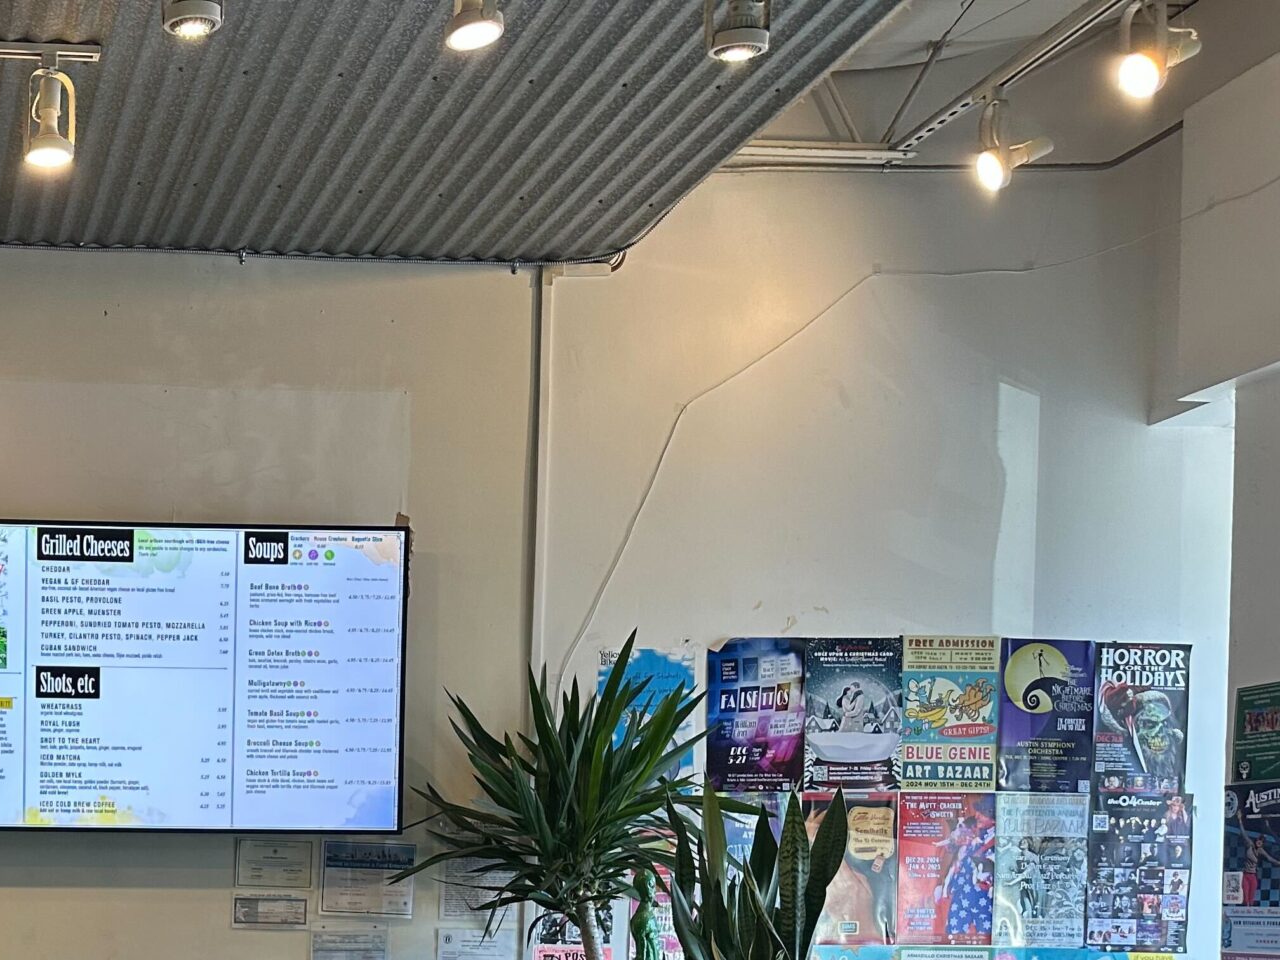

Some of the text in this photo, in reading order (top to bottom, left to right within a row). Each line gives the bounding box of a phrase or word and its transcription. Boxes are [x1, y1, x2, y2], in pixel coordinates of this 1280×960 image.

[41, 534, 81, 557] Grilled
[83, 534, 130, 557] Cheeses
[249, 537, 284, 562] Soups
[274, 620, 288, 628] Soup
[908, 638, 995, 648] FREE ADMISSION
[1101, 648, 1185, 668] HORROR
[40, 671, 95, 696] Shots, etc
[1100, 669, 1185, 687] HOLIDAYS
[1052, 684, 1093, 697] NIGHTMARE
[1054, 701, 1092, 712] CHRISTMAS
[943, 727, 967, 736] GREAT
[906, 746, 991, 761] BLUE GENIE
[246, 769, 269, 777] Chicken
[292, 770, 307, 778] Soup
[906, 765, 990, 779] ART BAZAAR
